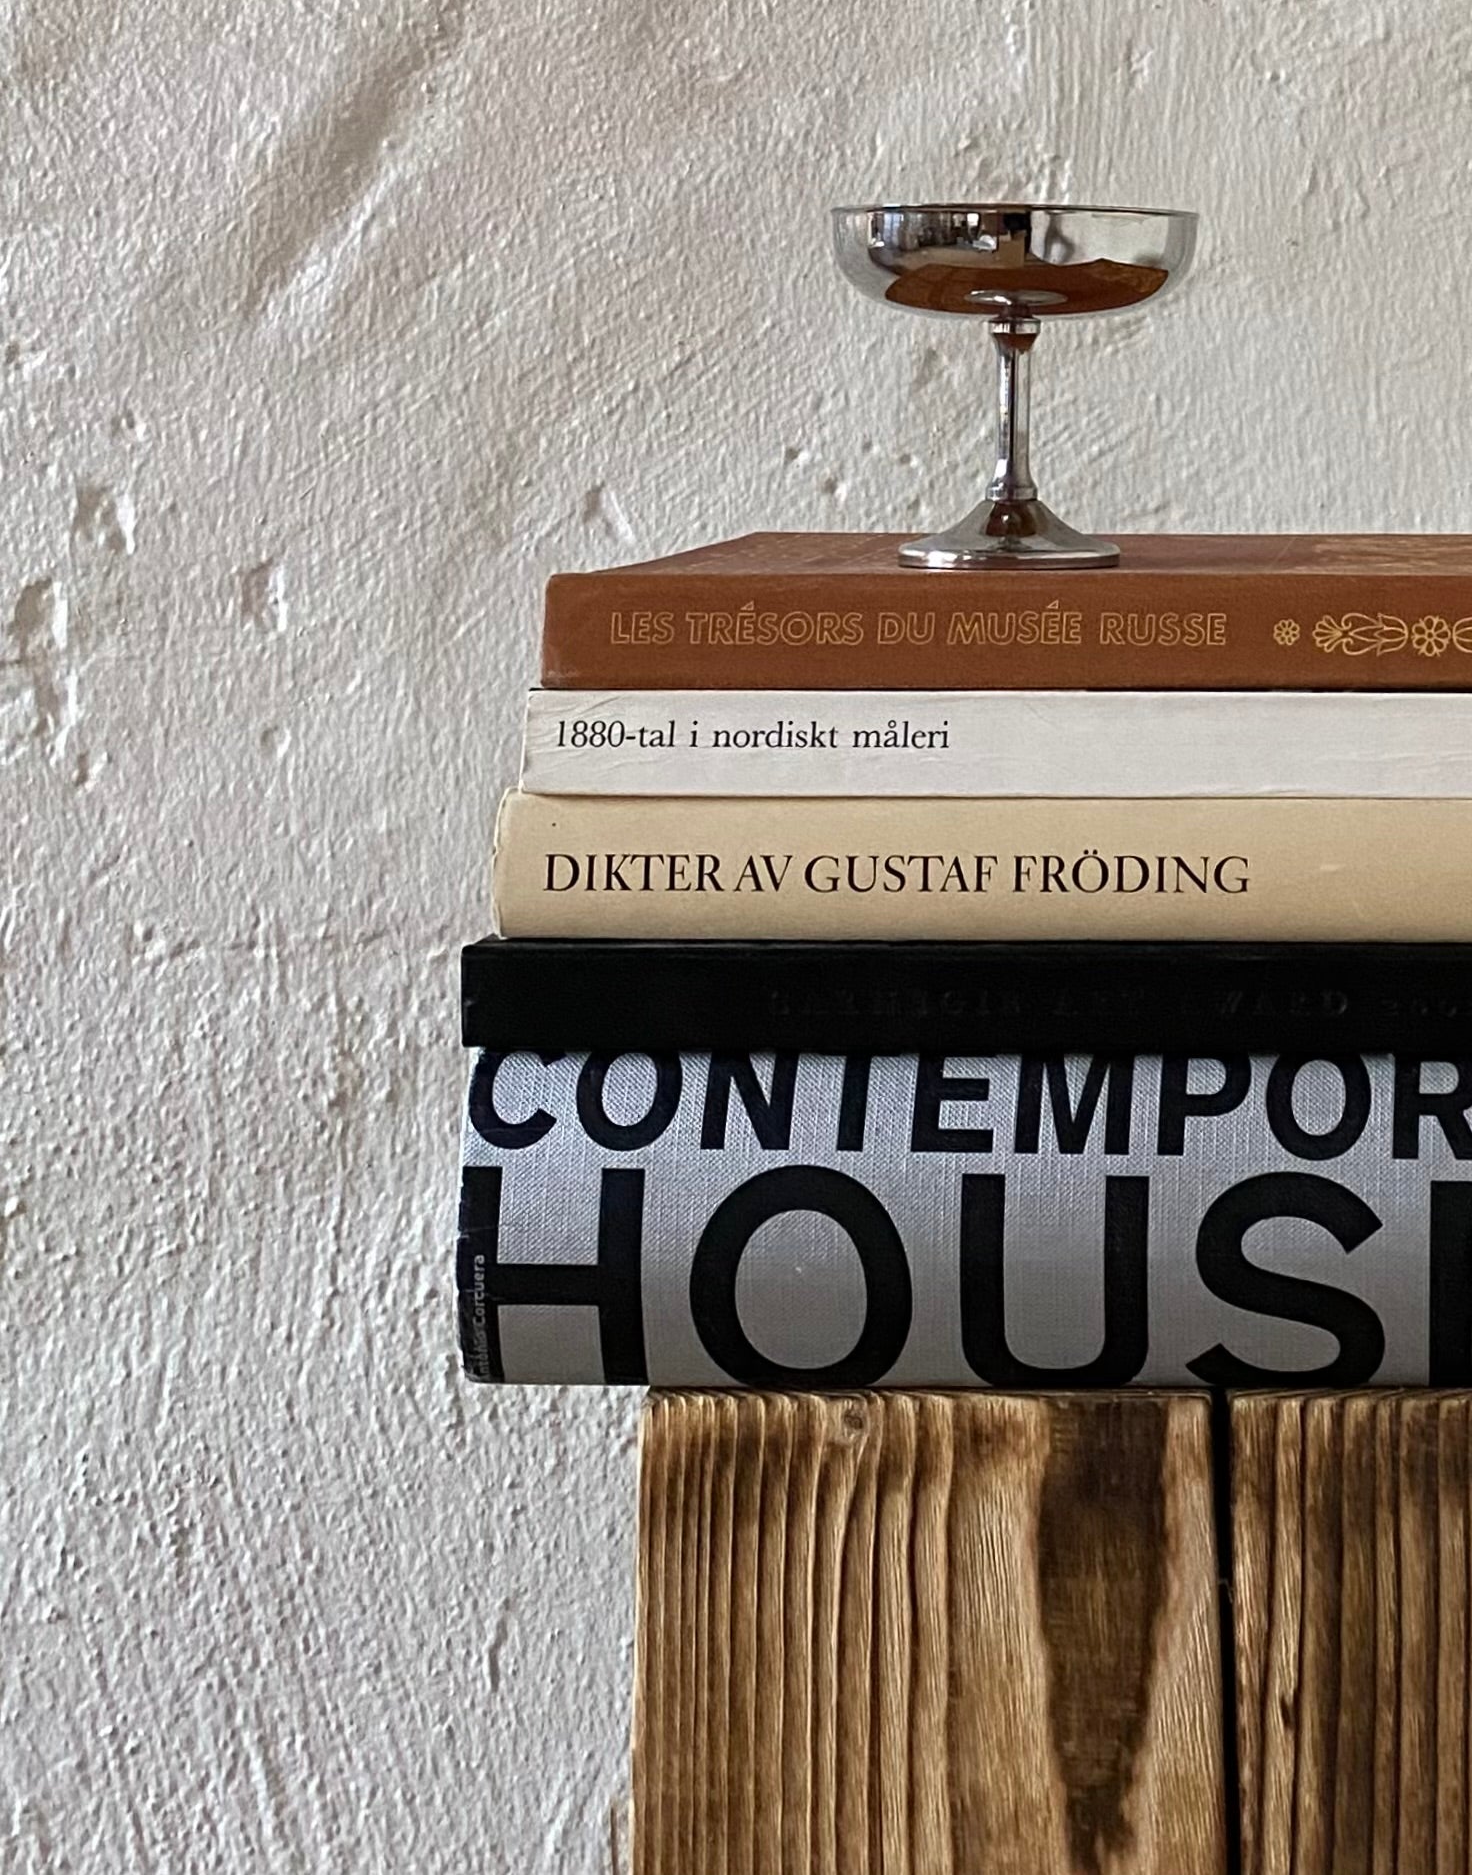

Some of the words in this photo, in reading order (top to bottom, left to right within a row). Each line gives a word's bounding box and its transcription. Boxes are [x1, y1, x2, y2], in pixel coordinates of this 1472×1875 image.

[609, 611, 675, 646] LES
[686, 601, 865, 646] TRÉSORS
[875, 611, 937, 646] DU
[946, 599, 1083, 646] MUSÉE
[1099, 612, 1227, 647] RUSSE
[556, 719, 676, 750] 1880-tal
[688, 720, 699, 749] i
[711, 719, 839, 750] nordiskt
[851, 719, 950, 751] måleri
[543, 853, 724, 894] DIKTER
[733, 854, 793, 894] AV
[804, 854, 999, 895] GUSTAF
[1012, 849, 1250, 895] FRÖDING
